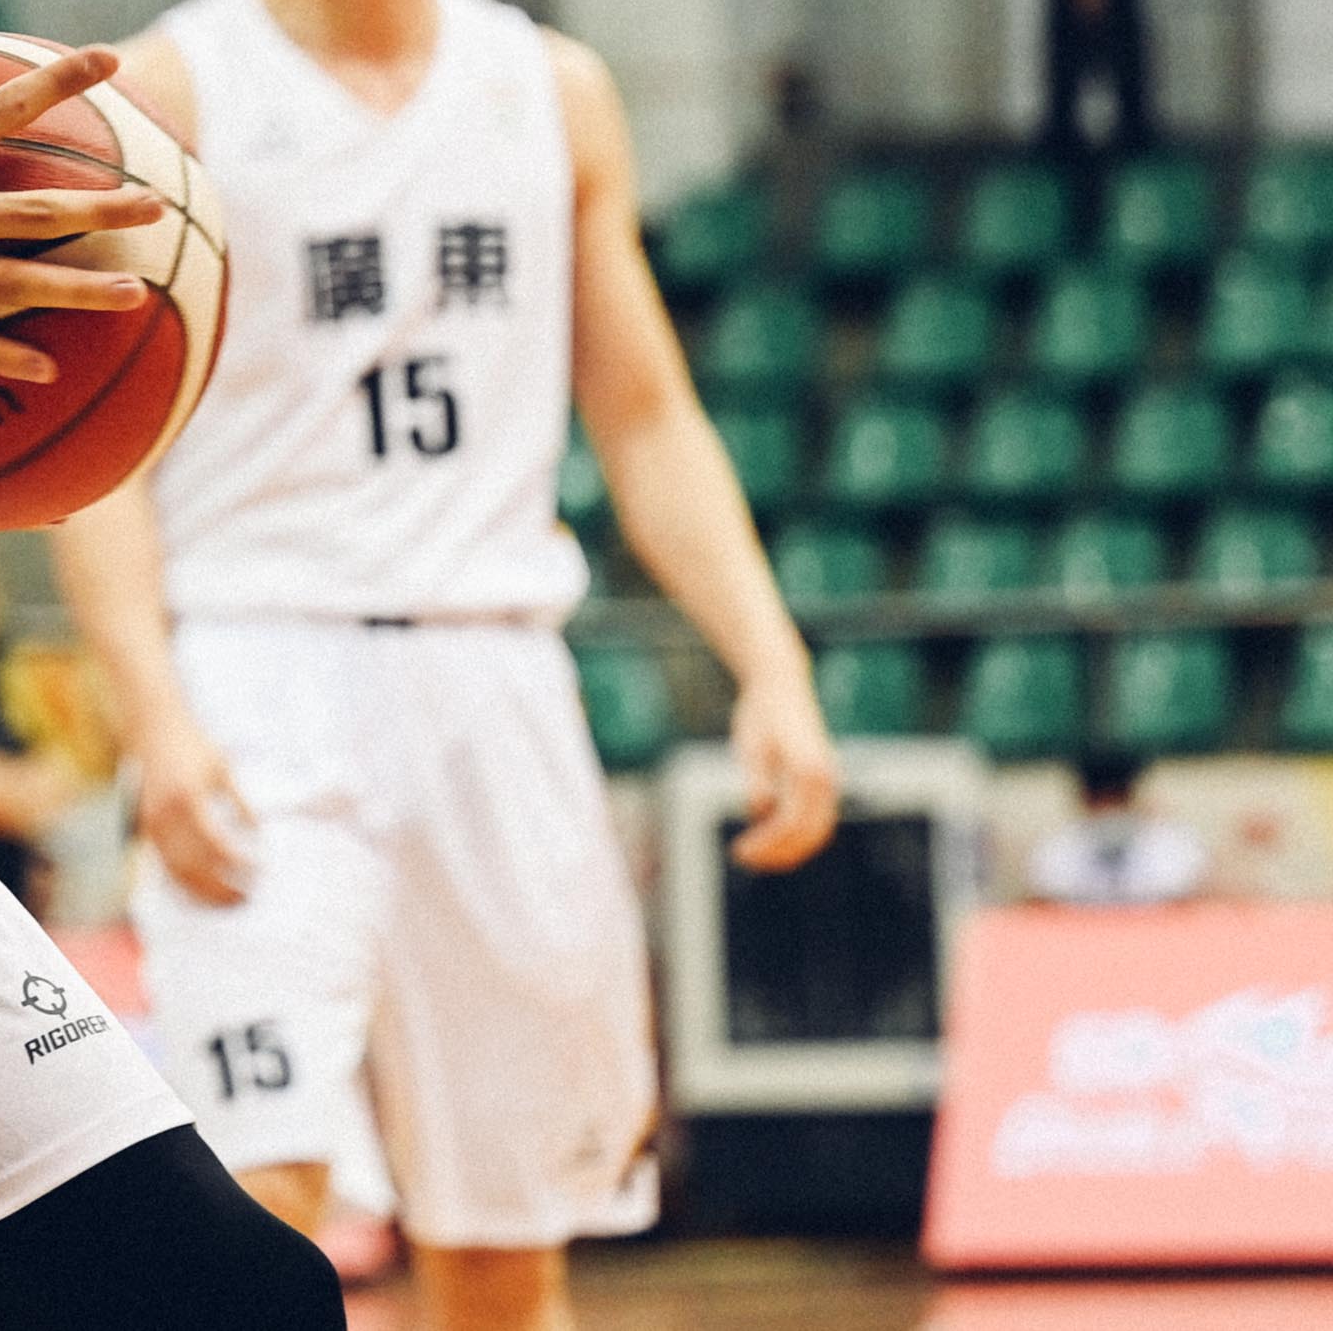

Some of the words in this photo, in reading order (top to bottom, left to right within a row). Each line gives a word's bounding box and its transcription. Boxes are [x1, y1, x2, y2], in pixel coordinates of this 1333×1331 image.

[305, 222, 509, 322] 廣東
[356, 354, 460, 457] 15
[23, 1014, 111, 1066] RIGORER
[209, 1017, 292, 1101] 15
